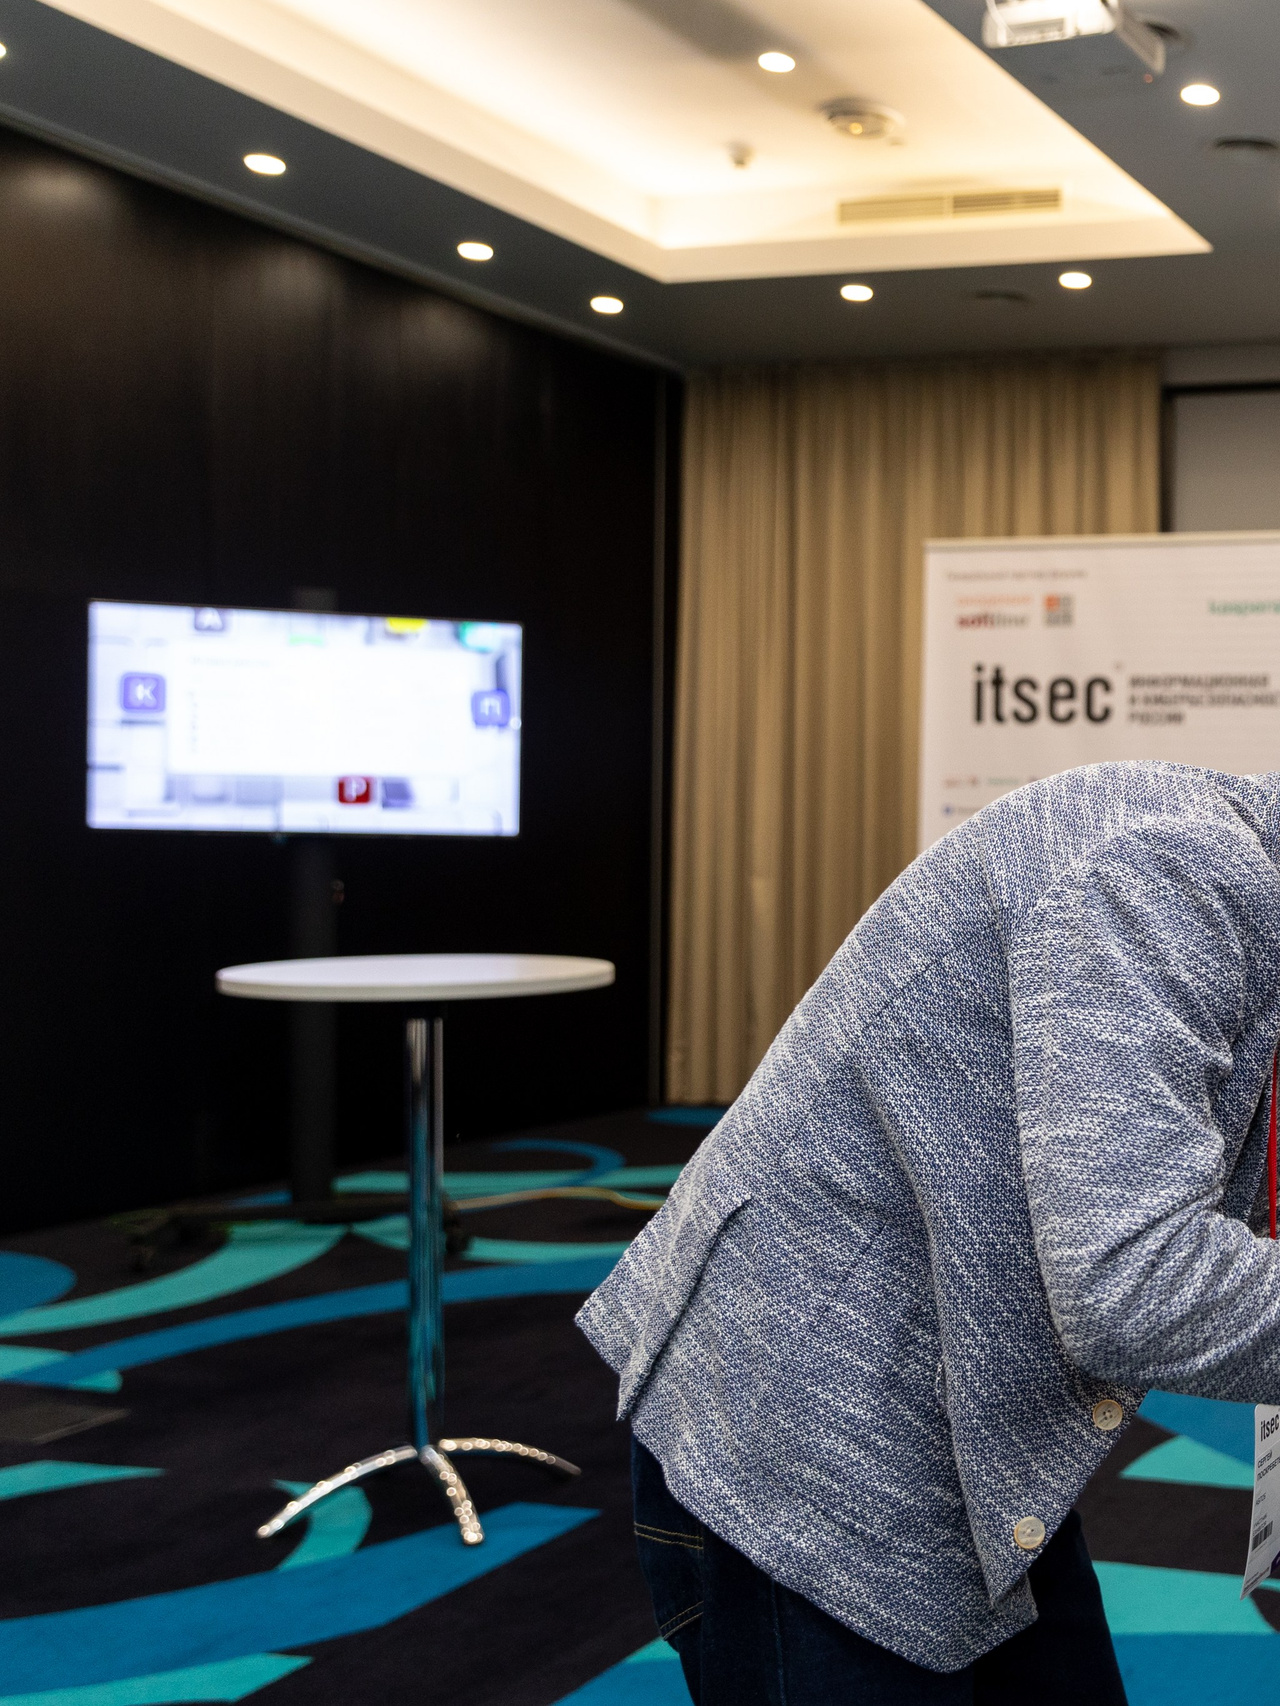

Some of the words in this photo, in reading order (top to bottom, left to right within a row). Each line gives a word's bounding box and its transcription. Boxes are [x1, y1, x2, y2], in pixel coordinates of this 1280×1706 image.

[976, 664, 1111, 723] itsec
[1260, 1414, 1280, 1441] itsec
[1258, 1450, 1272, 1468] СЕРГЕЙ
